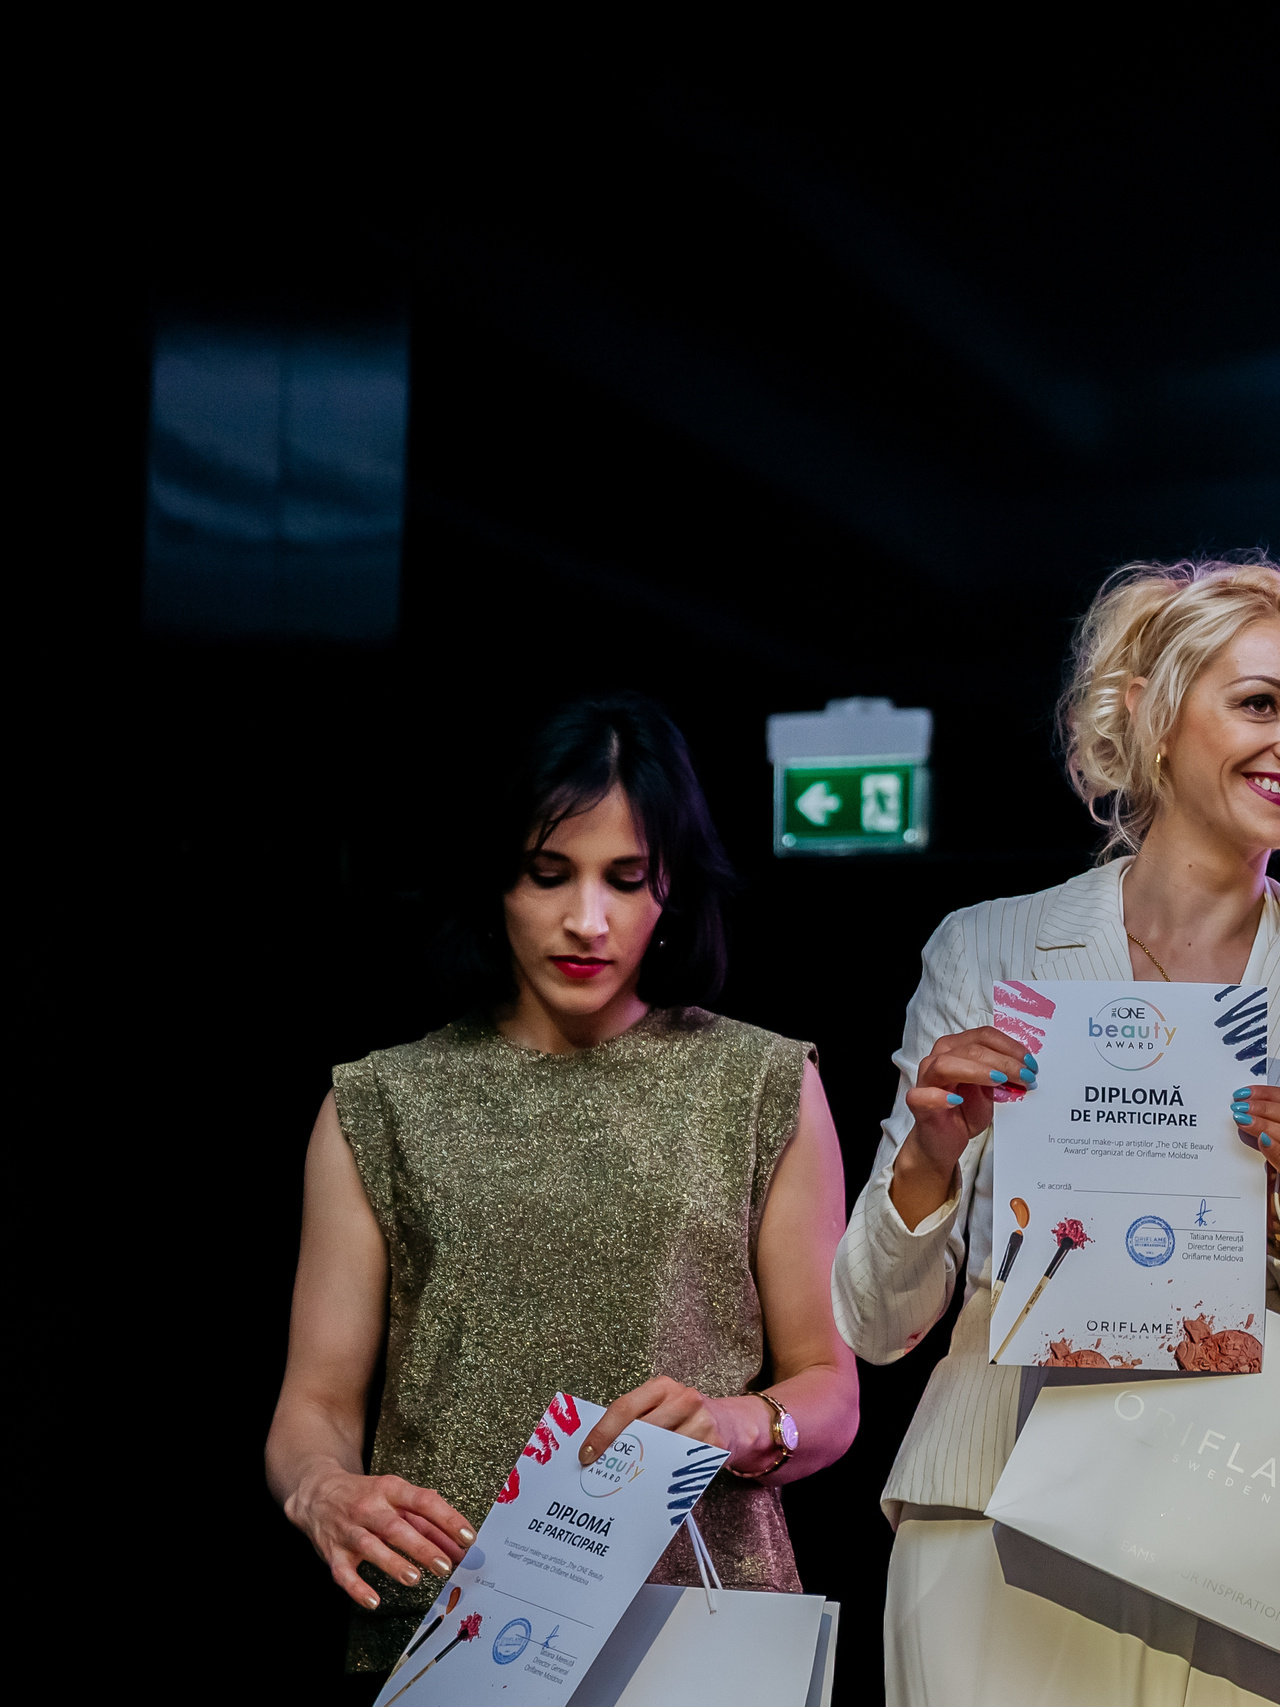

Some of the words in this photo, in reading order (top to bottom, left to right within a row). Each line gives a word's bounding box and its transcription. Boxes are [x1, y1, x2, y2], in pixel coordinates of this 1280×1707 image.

[1117, 1006, 1145, 1019] ONE
[1088, 1017, 1177, 1046] beauty
[1105, 1041, 1154, 1050] AWARD
[1084, 1085, 1184, 1106] DIPLOMĂ
[1070, 1109, 1091, 1122] DE
[1096, 1110, 1197, 1127] PARTICIPARE
[1056, 1137, 1091, 1145] concursul
[1092, 1138, 1124, 1147] make-up
[1171, 1141, 1188, 1149] ONE
[1190, 1142, 1214, 1152] Beauty
[1090, 1148, 1124, 1158] organizat
[1125, 1149, 1135, 1157] de
[1136, 1150, 1166, 1158] Oriflame
[1167, 1152, 1199, 1160] Moldova
[1037, 1181, 1046, 1190] Se
[1189, 1232, 1214, 1241] Tatiana
[1187, 1242, 1215, 1251] Director
[1216, 1243, 1244, 1252] General
[1181, 1252, 1212, 1261] Oriflame
[1213, 1253, 1244, 1262] Moldova
[1086, 1319, 1174, 1335] ORIFLAME
[613, 1441, 636, 1456] ONE
[588, 1467, 621, 1483] AWARD
[595, 1453, 645, 1483] eauty
[1171, 1453, 1272, 1504] SWEDEN
[546, 1501, 615, 1537] DIPLOMĂ
[527, 1518, 545, 1533] DE
[542, 1524, 610, 1557] PARTICIPARE
[576, 1564, 589, 1575] ONE
[550, 1664, 570, 1676] General
